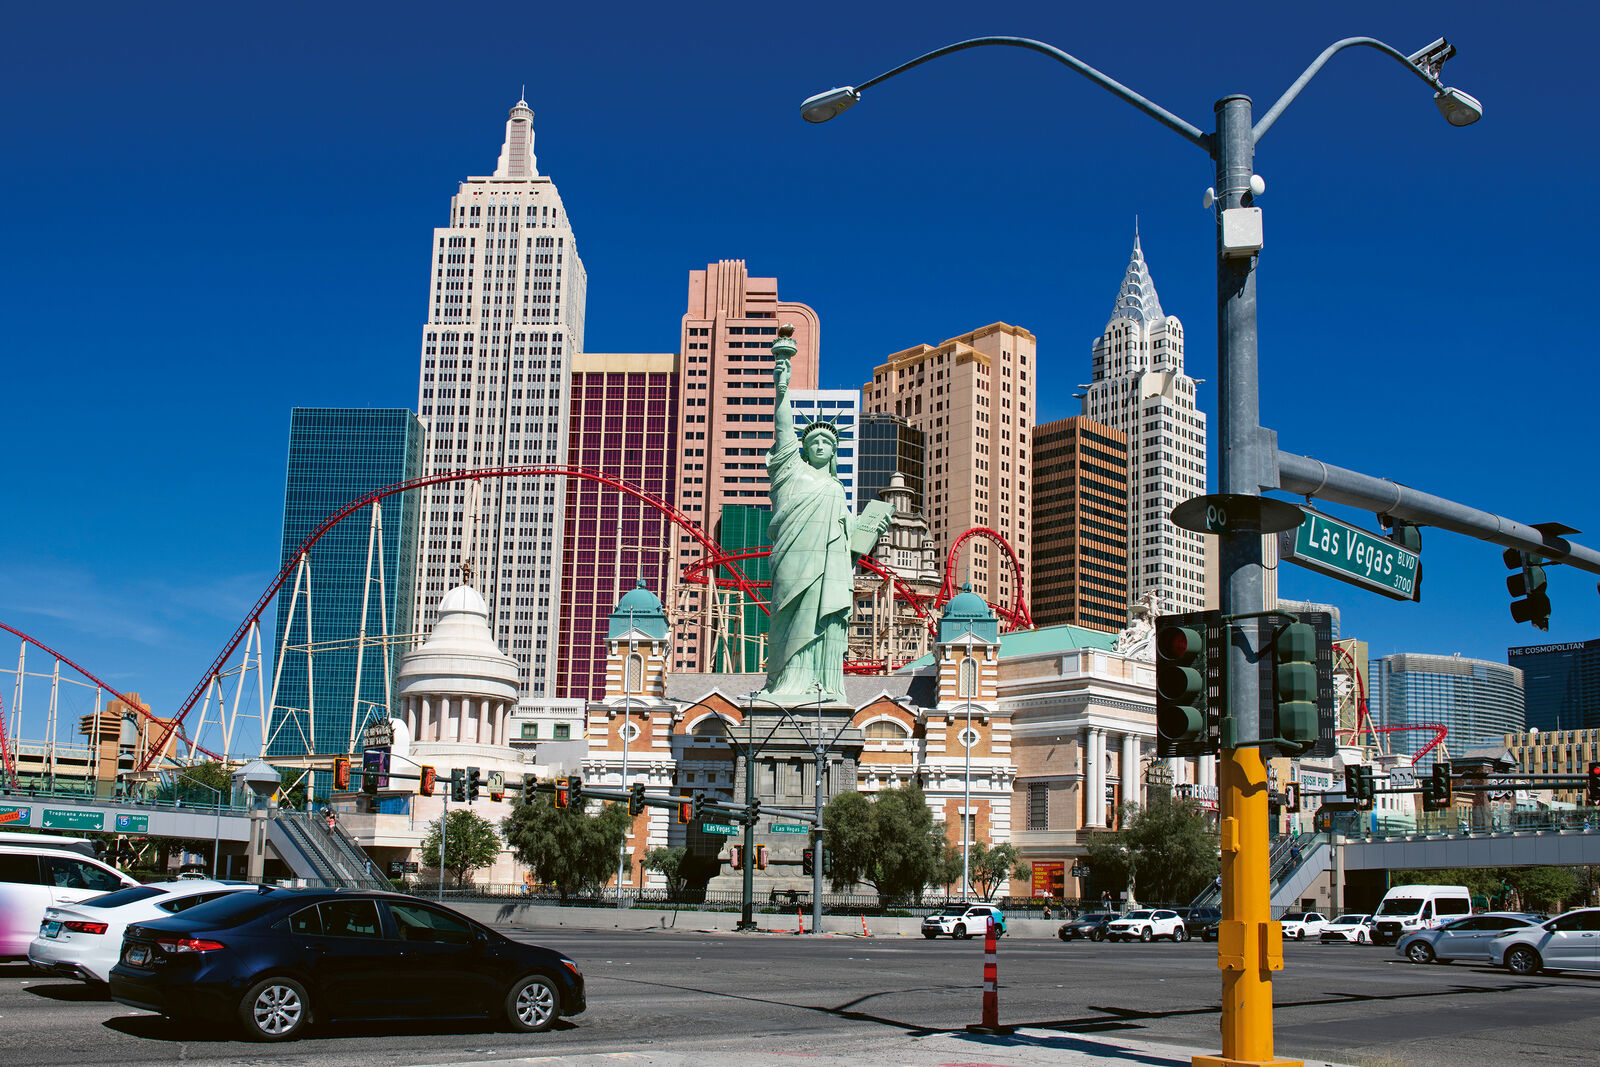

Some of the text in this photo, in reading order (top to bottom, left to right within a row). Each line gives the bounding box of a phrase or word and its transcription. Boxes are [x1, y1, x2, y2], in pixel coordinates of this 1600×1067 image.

[1309, 516, 1416, 576] Las Vegas BLVD
[1393, 574, 1412, 592] 3700
[1525, 642, 1585, 655] COSMOPOLITAN
[1301, 774, 1328, 787] IRISH PUB
[18, 811, 26, 819] 15
[120, 818, 128, 826] 15
[706, 824, 716, 832] Las
[716, 825, 730, 834] Vegas
